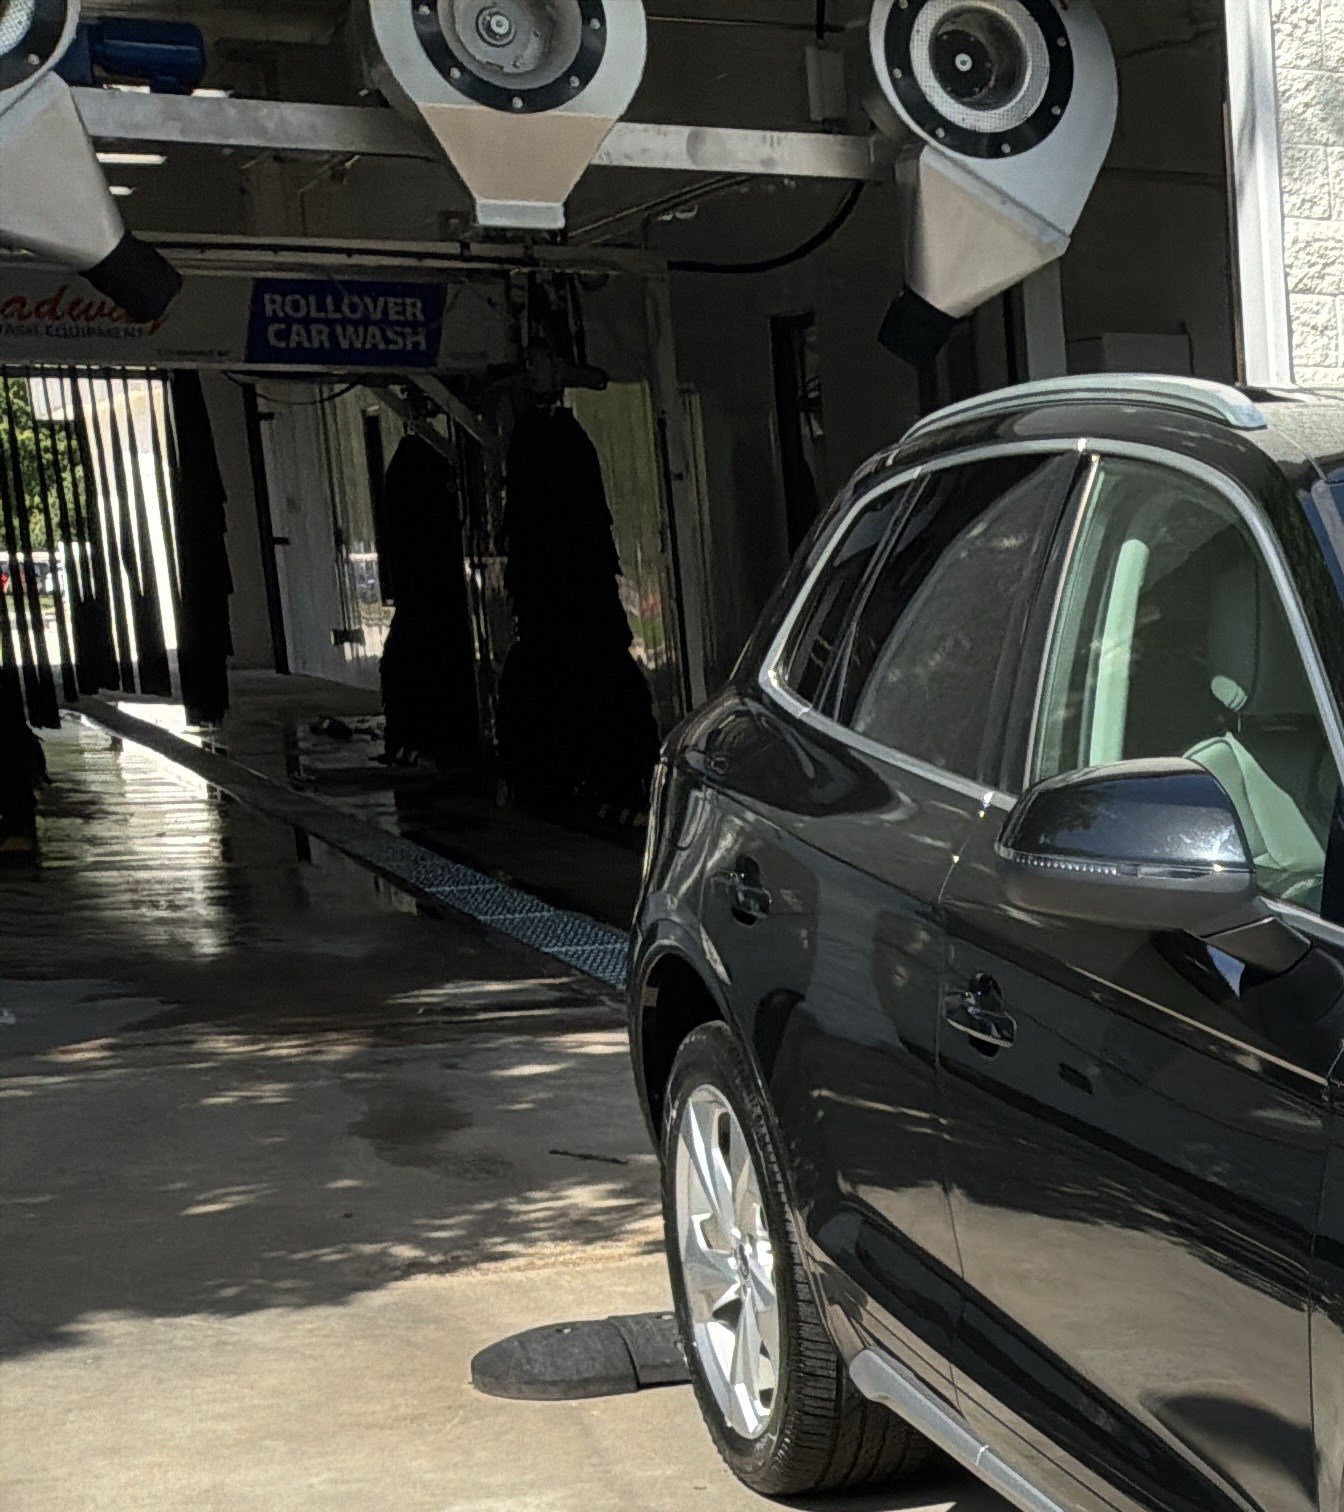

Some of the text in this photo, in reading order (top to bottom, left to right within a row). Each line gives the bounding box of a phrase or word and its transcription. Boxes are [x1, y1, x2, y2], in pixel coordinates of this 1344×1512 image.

[263, 293, 425, 321] ROLLOVER
[266, 323, 427, 351] CAR WASH
